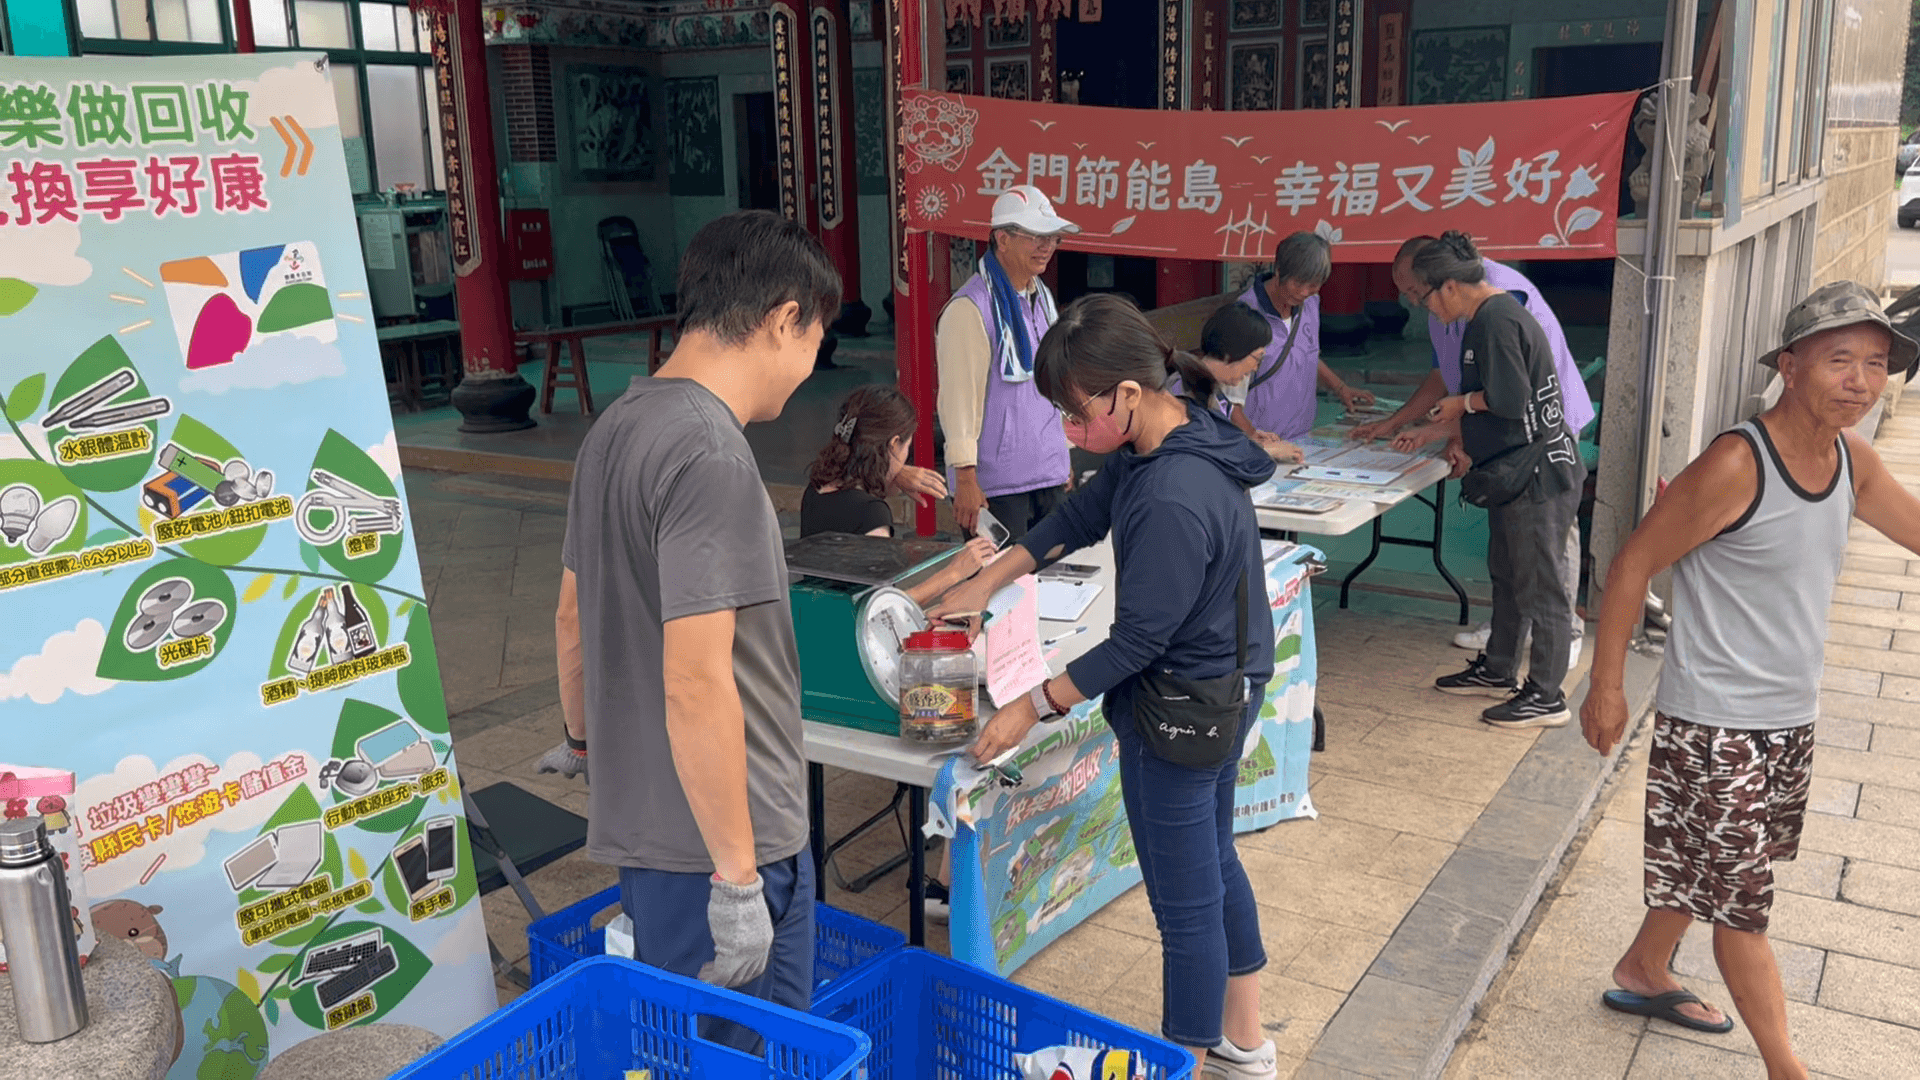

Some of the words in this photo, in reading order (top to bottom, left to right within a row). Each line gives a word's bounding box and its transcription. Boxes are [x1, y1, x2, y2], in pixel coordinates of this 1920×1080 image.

[0, 153, 268, 226] 換享好康
[977, 147, 1223, 214] 金門節能島
[1274, 137, 1562, 216] 幸福又美好
[1537, 374, 1576, 465] 197
[349, 534, 376, 553] 燈管
[162, 637, 210, 663] 光碟片
[411, 890, 452, 919] 廢手機
